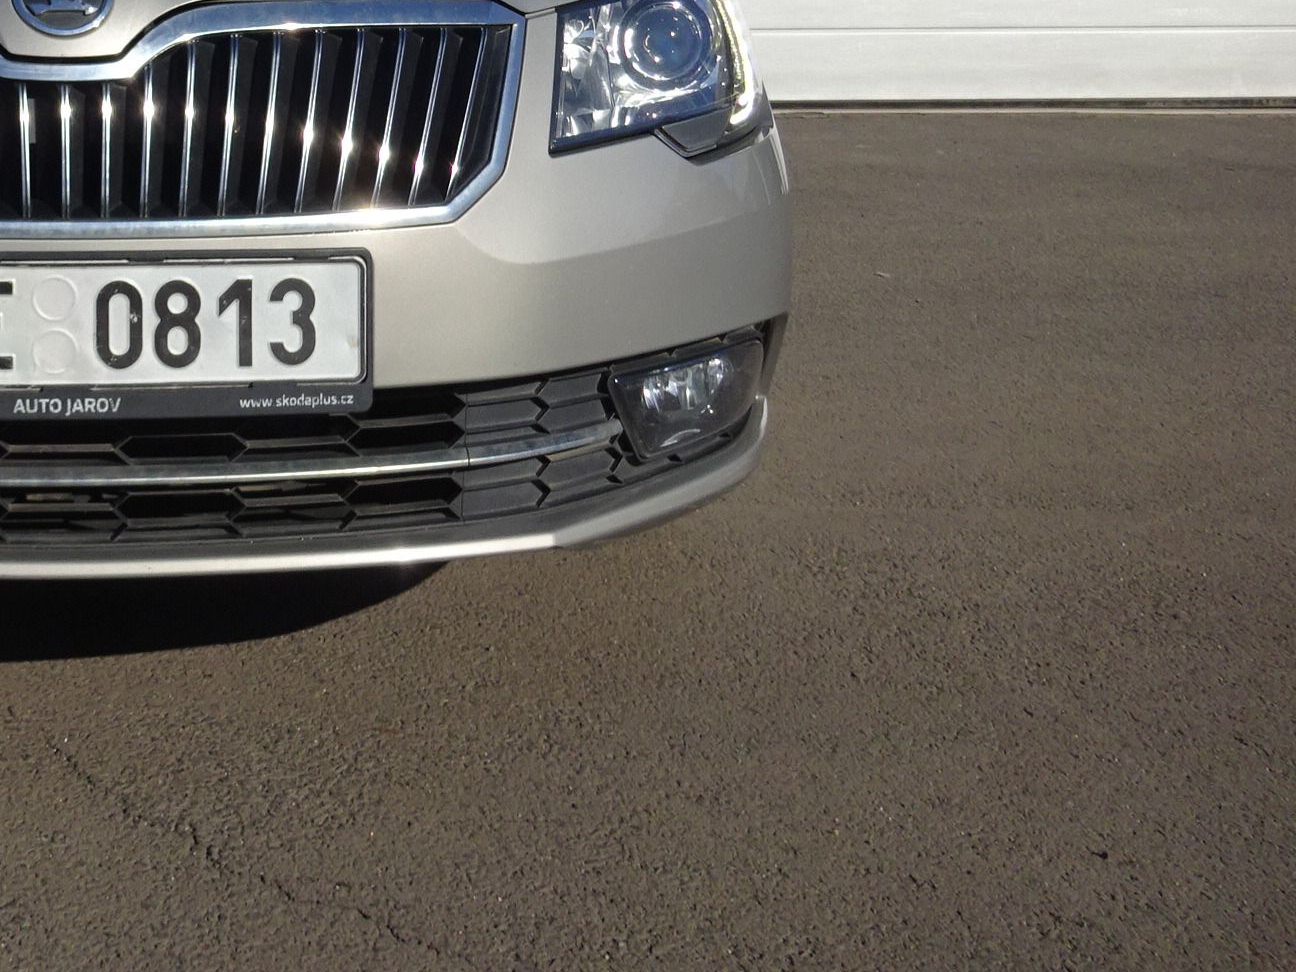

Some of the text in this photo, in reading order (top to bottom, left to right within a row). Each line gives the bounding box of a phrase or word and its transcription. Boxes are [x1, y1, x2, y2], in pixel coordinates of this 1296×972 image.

[94, 278, 318, 370] 0813
[13, 397, 122, 417] AUTO JAROV
